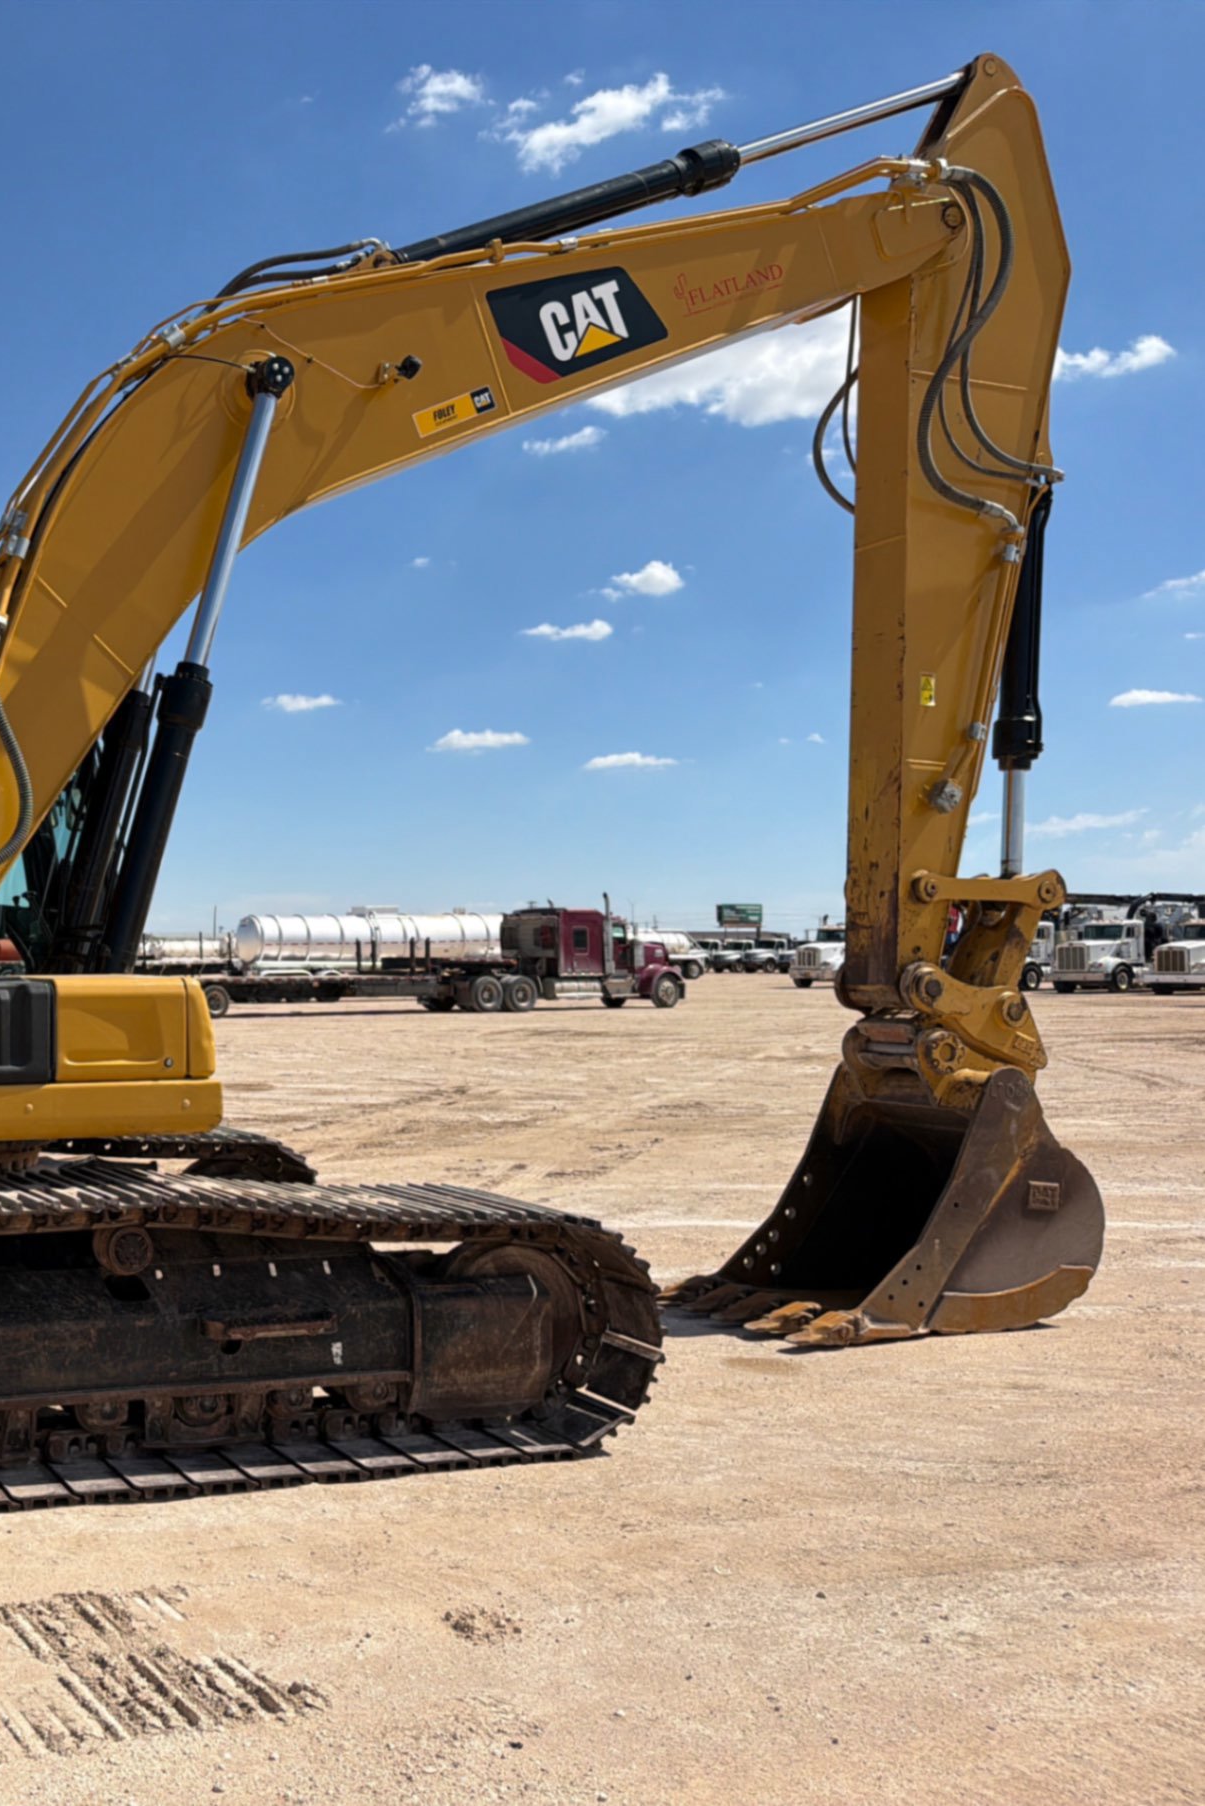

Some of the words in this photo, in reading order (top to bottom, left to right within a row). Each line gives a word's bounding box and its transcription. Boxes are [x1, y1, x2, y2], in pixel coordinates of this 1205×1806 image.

[688, 264, 783, 306] FLATLAND
[539, 280, 629, 362] CAT
[433, 404, 456, 421] FOLEY
[474, 392, 492, 408] CAT
